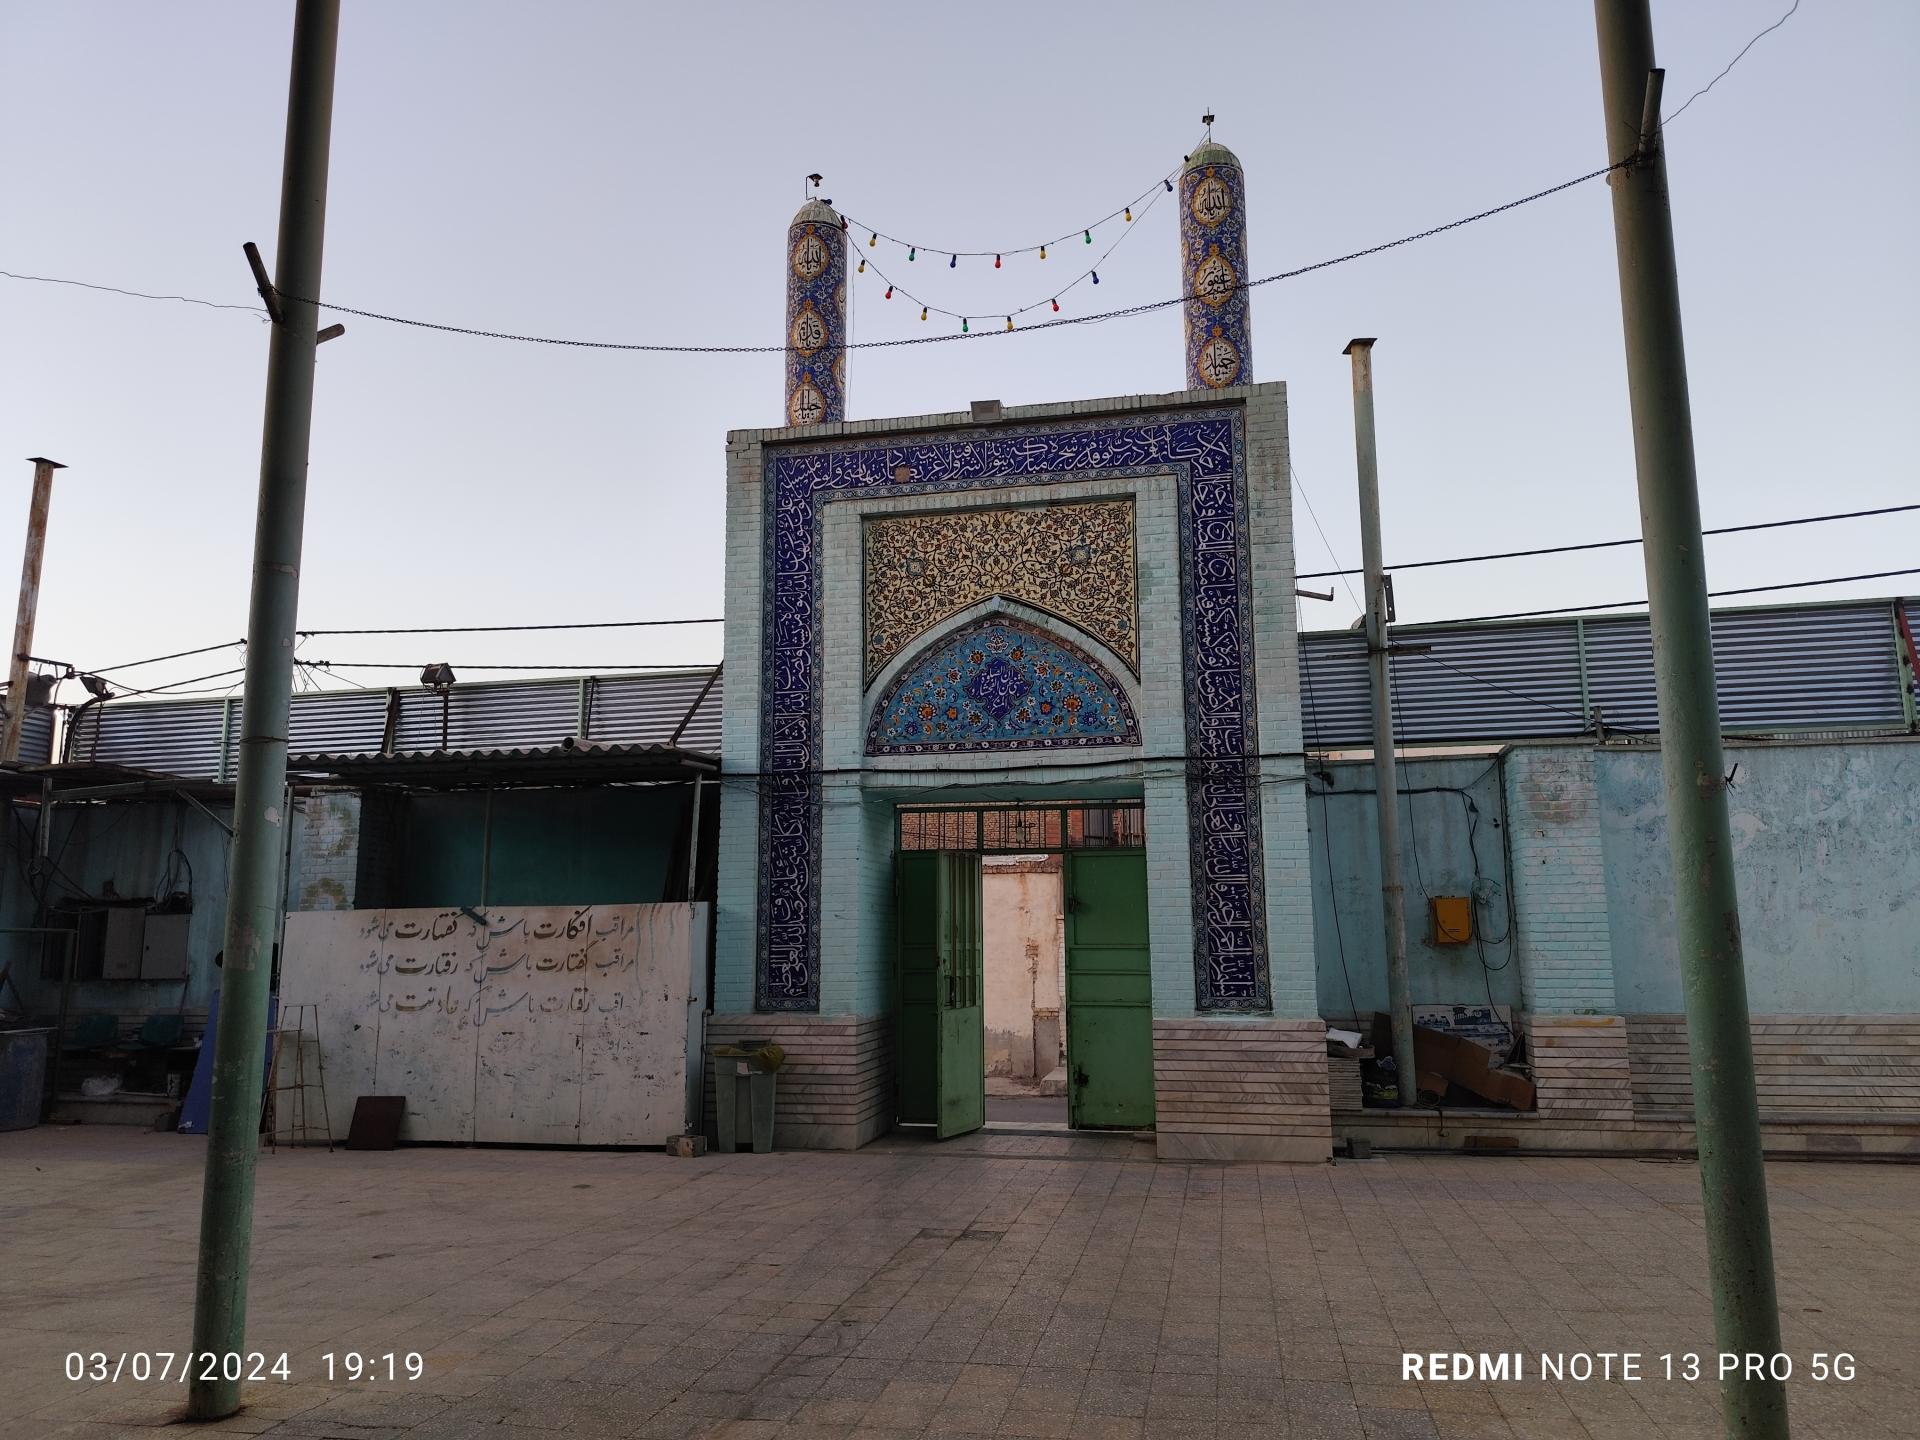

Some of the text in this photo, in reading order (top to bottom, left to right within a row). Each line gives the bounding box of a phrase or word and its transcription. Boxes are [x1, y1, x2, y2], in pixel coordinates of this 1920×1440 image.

[595, 914, 634, 942] مراقب
[395, 951, 459, 976] رفتارت
[595, 948, 635, 977] مراقب
